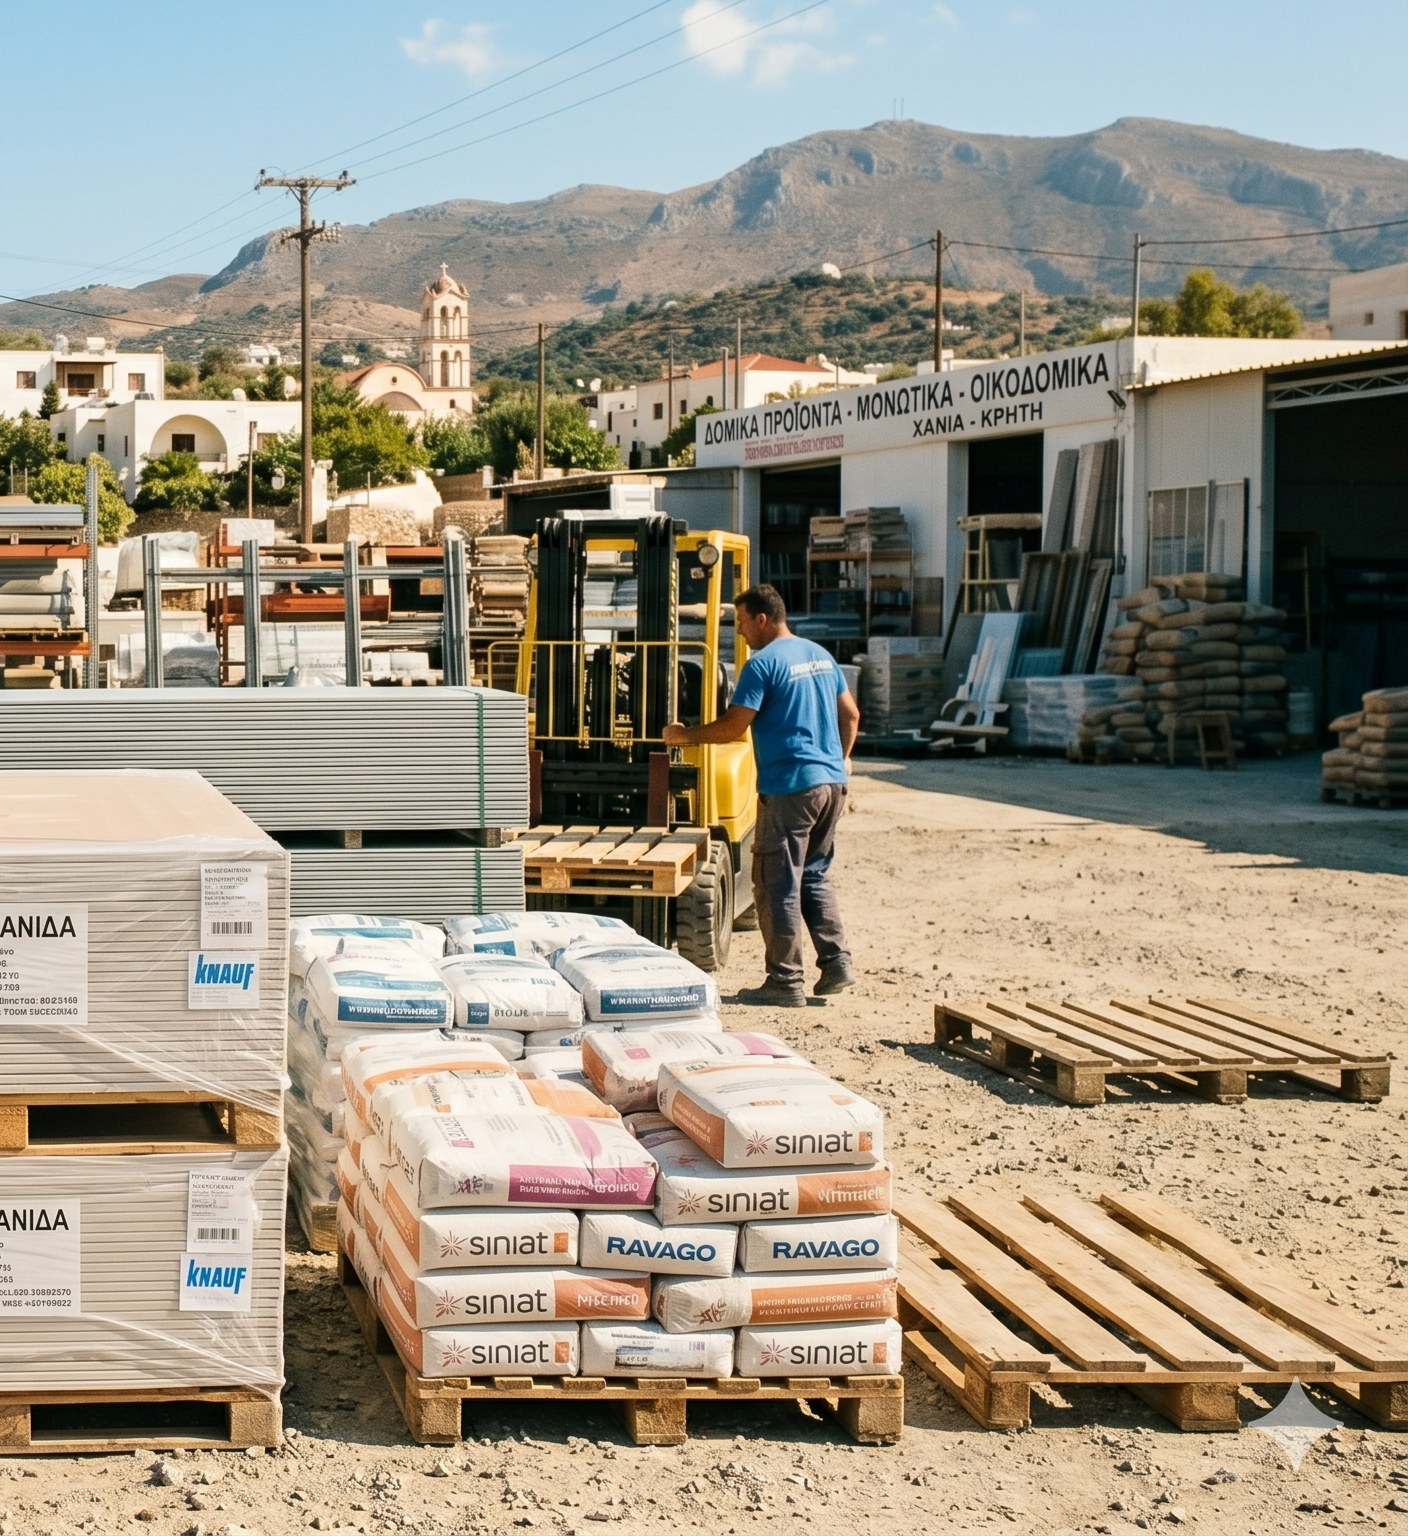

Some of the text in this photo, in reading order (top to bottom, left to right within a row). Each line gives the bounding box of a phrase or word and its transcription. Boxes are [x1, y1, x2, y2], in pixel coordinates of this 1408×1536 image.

[704, 414, 759, 446] ΔΟΜΙΚΑ
[764, 400, 842, 436] ΠΡΟΪΟΝΤΑ
[857, 380, 953, 421] ΜΟΝΩΤΙΚΑ
[971, 353, 1110, 403] ΟΙΚΟΔΟΜΙΚΑ
[913, 414, 965, 438] ΧΑΝΙΑ
[981, 401, 1043, 428] ΚΡΗΤΗ
[775, 1131, 853, 1155] siniat
[707, 1188, 789, 1213] siniat
[469, 1232, 548, 1256] siniat
[606, 1236, 716, 1262] RAVAGO
[772, 1238, 880, 1259] RAVAGO
[465, 1289, 547, 1315] siniat
[471, 1339, 549, 1365] siniat
[790, 1339, 868, 1365] siniat
